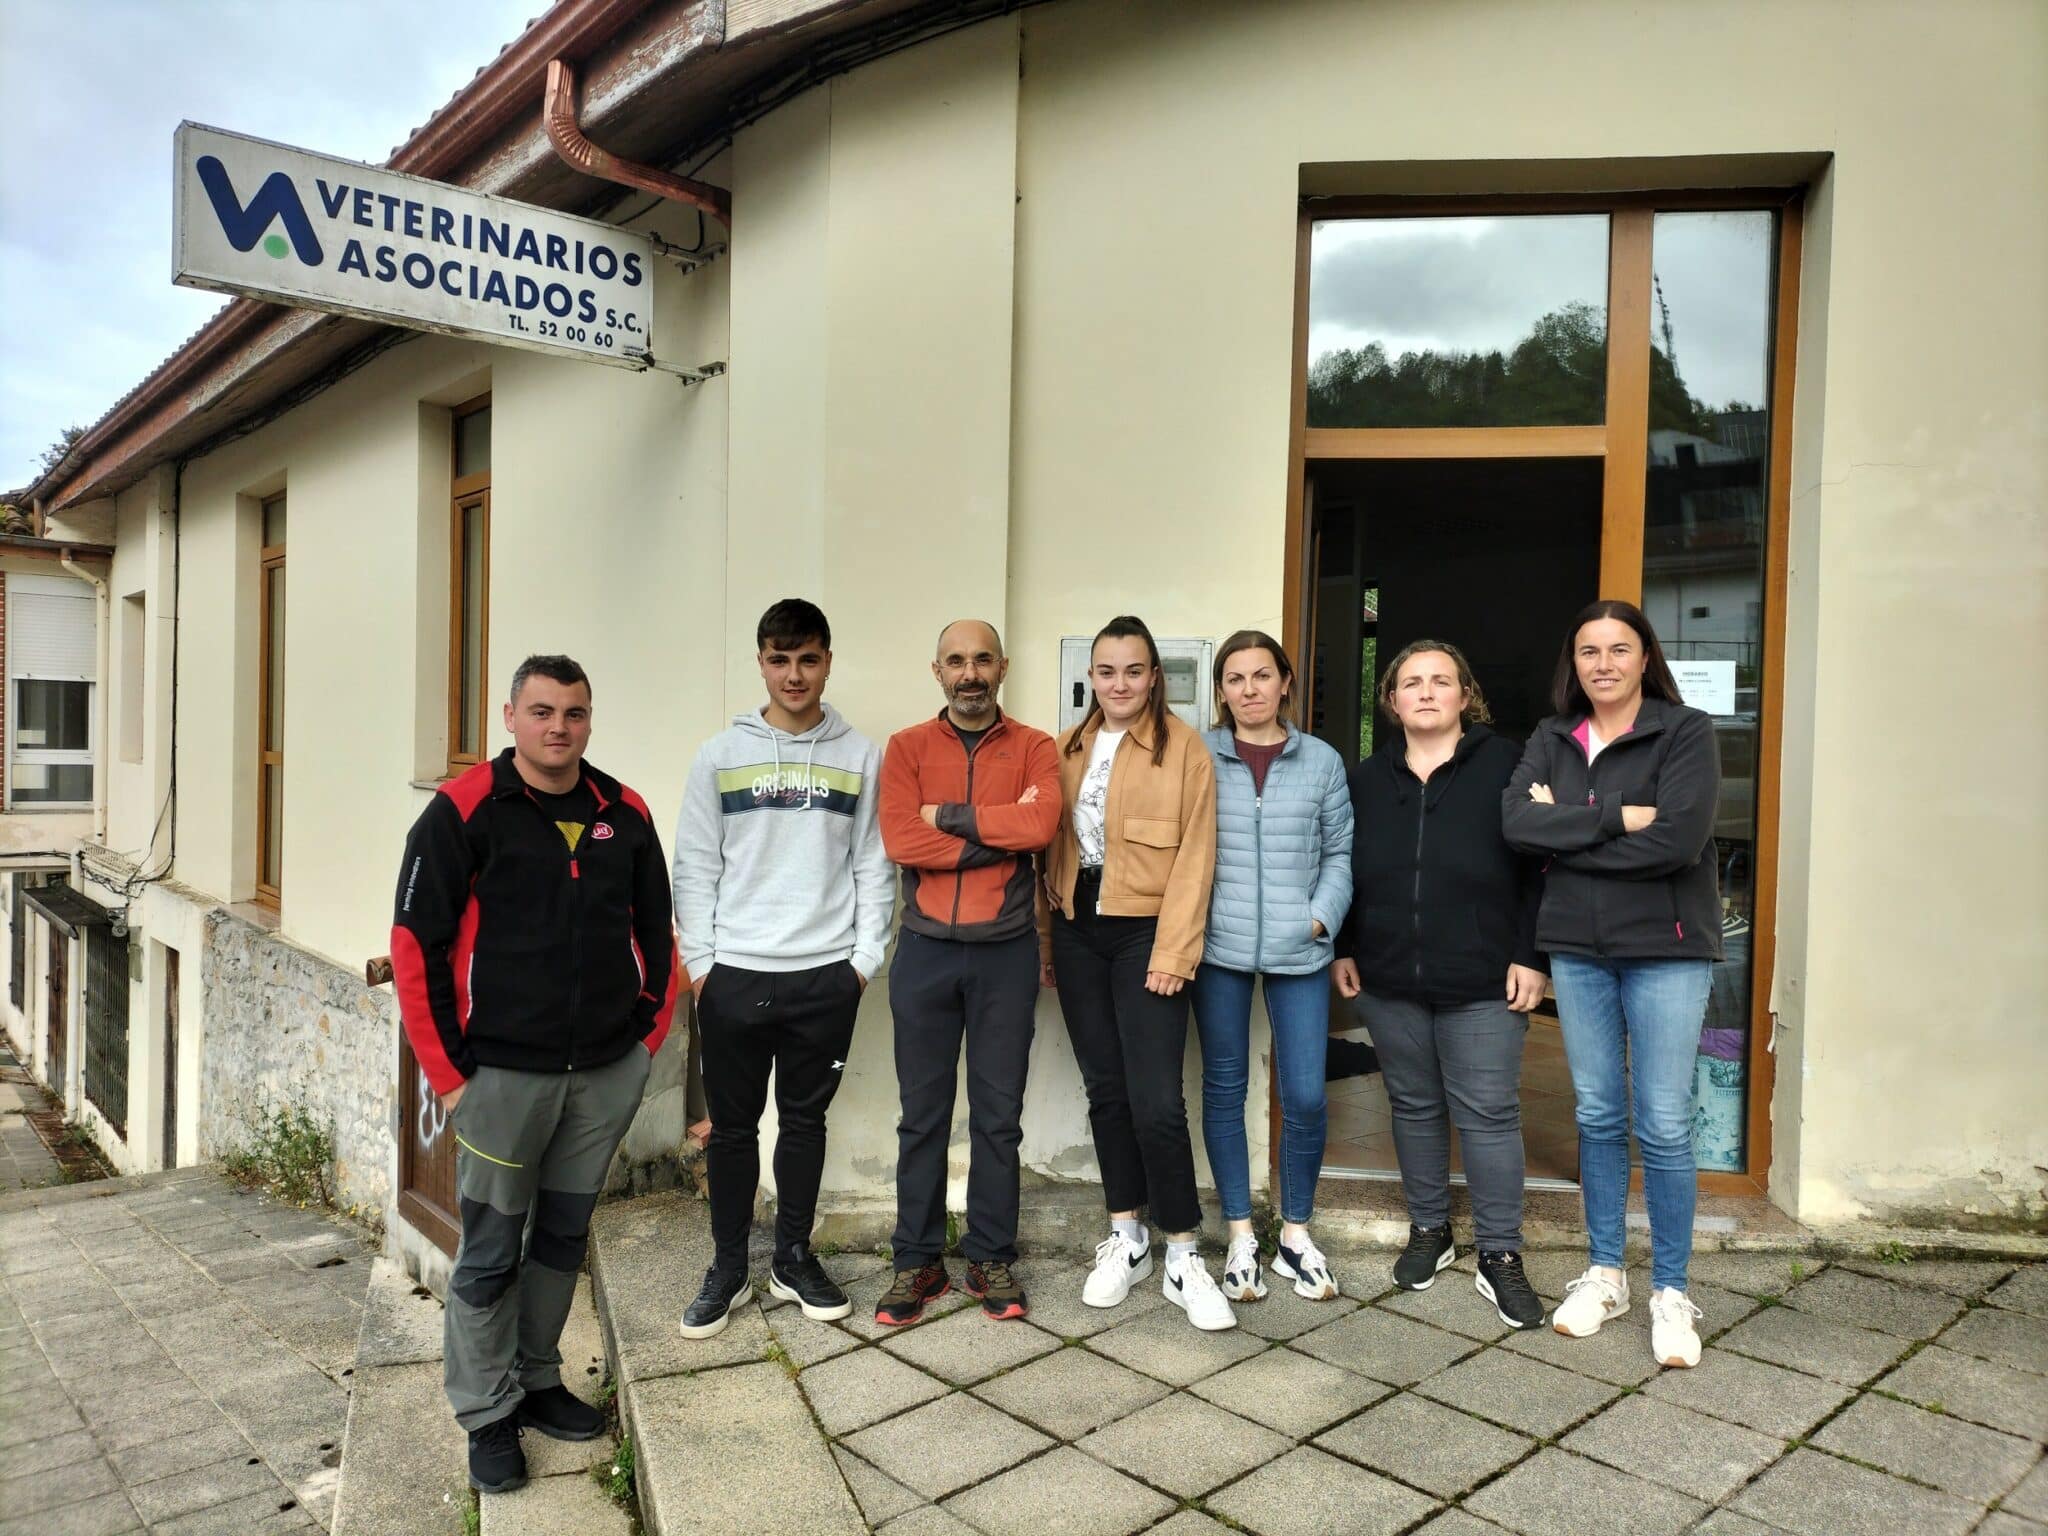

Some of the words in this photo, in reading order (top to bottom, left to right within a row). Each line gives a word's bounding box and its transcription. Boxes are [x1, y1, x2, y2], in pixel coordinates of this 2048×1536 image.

[315, 179, 643, 287] VETERINARIOS
[337, 239, 598, 324] ASOCIADOS
[605, 308, 643, 334] S.C.
[508, 314, 529, 332] TL.
[539, 320, 558, 337] 52
[566, 325, 586, 343] 00
[594, 331, 613, 348] 60
[752, 769, 829, 798] ORIGINALS
